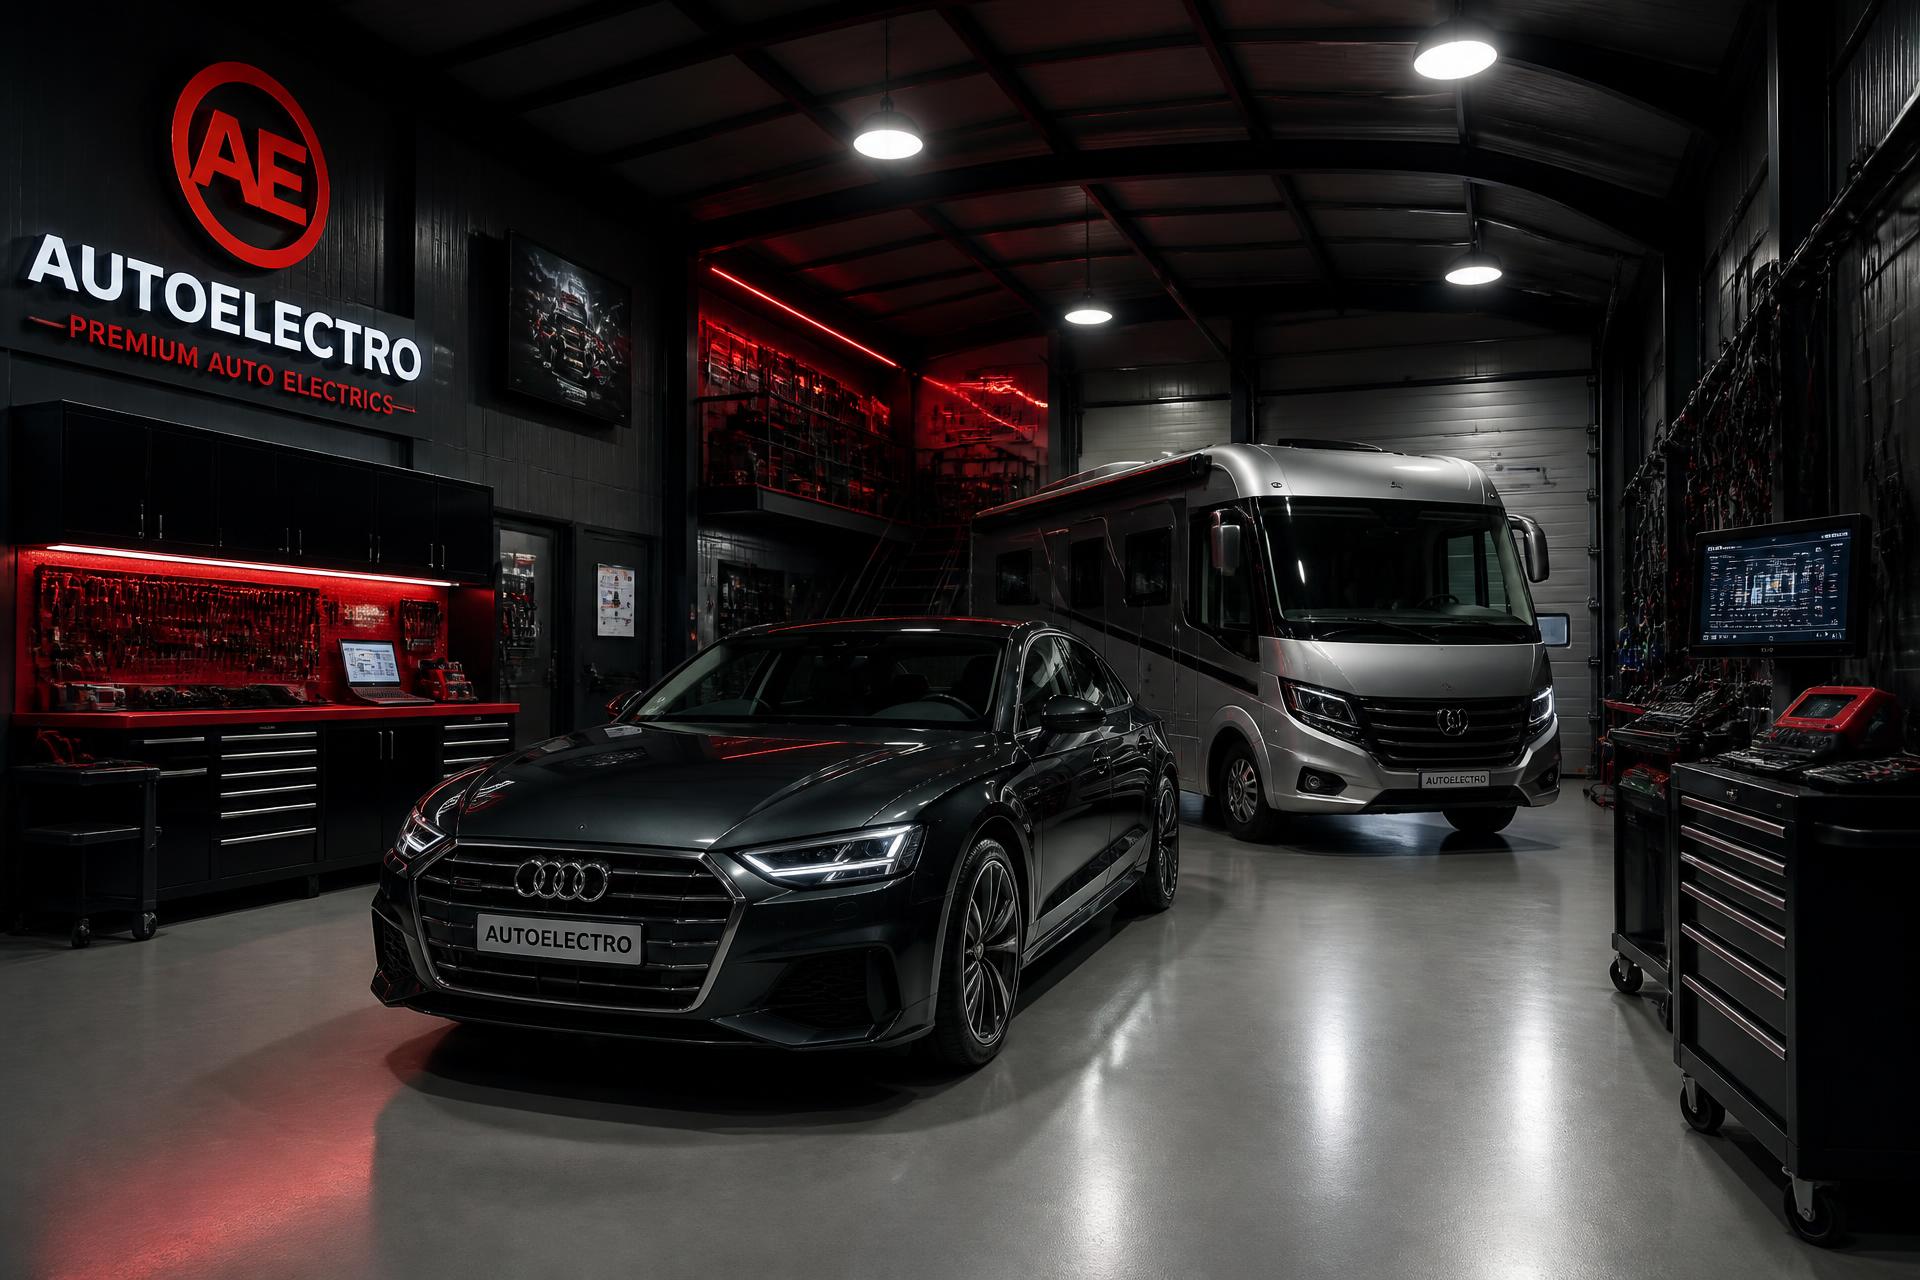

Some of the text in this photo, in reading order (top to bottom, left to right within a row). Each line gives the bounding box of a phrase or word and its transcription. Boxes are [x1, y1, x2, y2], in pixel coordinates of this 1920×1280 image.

[191, 108, 308, 228] AE
[27, 233, 422, 382] AUTOELECTRO
[69, 314, 395, 416] PREMIUM AUTO ELECTRICS
[1425, 775, 1487, 785] AUTOELECTRO
[485, 925, 632, 953] AUTOELECTRO
